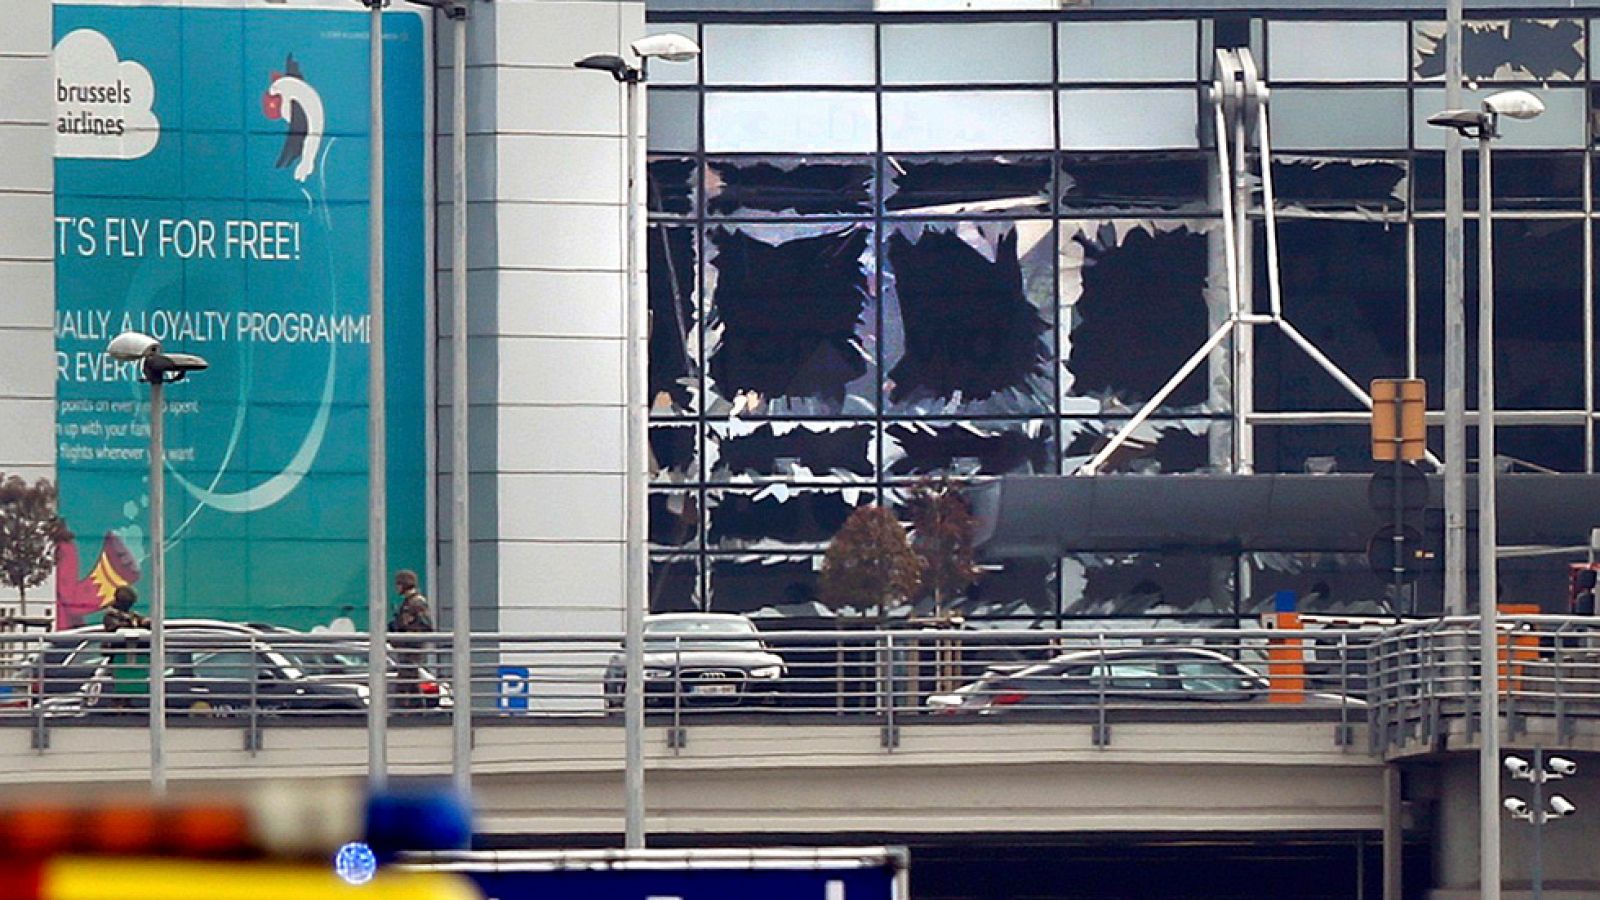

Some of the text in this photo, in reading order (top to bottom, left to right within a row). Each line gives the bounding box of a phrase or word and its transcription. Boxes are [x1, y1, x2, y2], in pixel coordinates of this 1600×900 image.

[57, 78, 131, 103] brussels
[57, 111, 125, 136] airlines
[55, 217, 96, 256] T'S
[105, 218, 149, 257] FLY
[159, 219, 216, 259] FOR
[141, 311, 230, 341] LOYALTY
[56, 352, 69, 382] R
[502, 674, 524, 707] P
